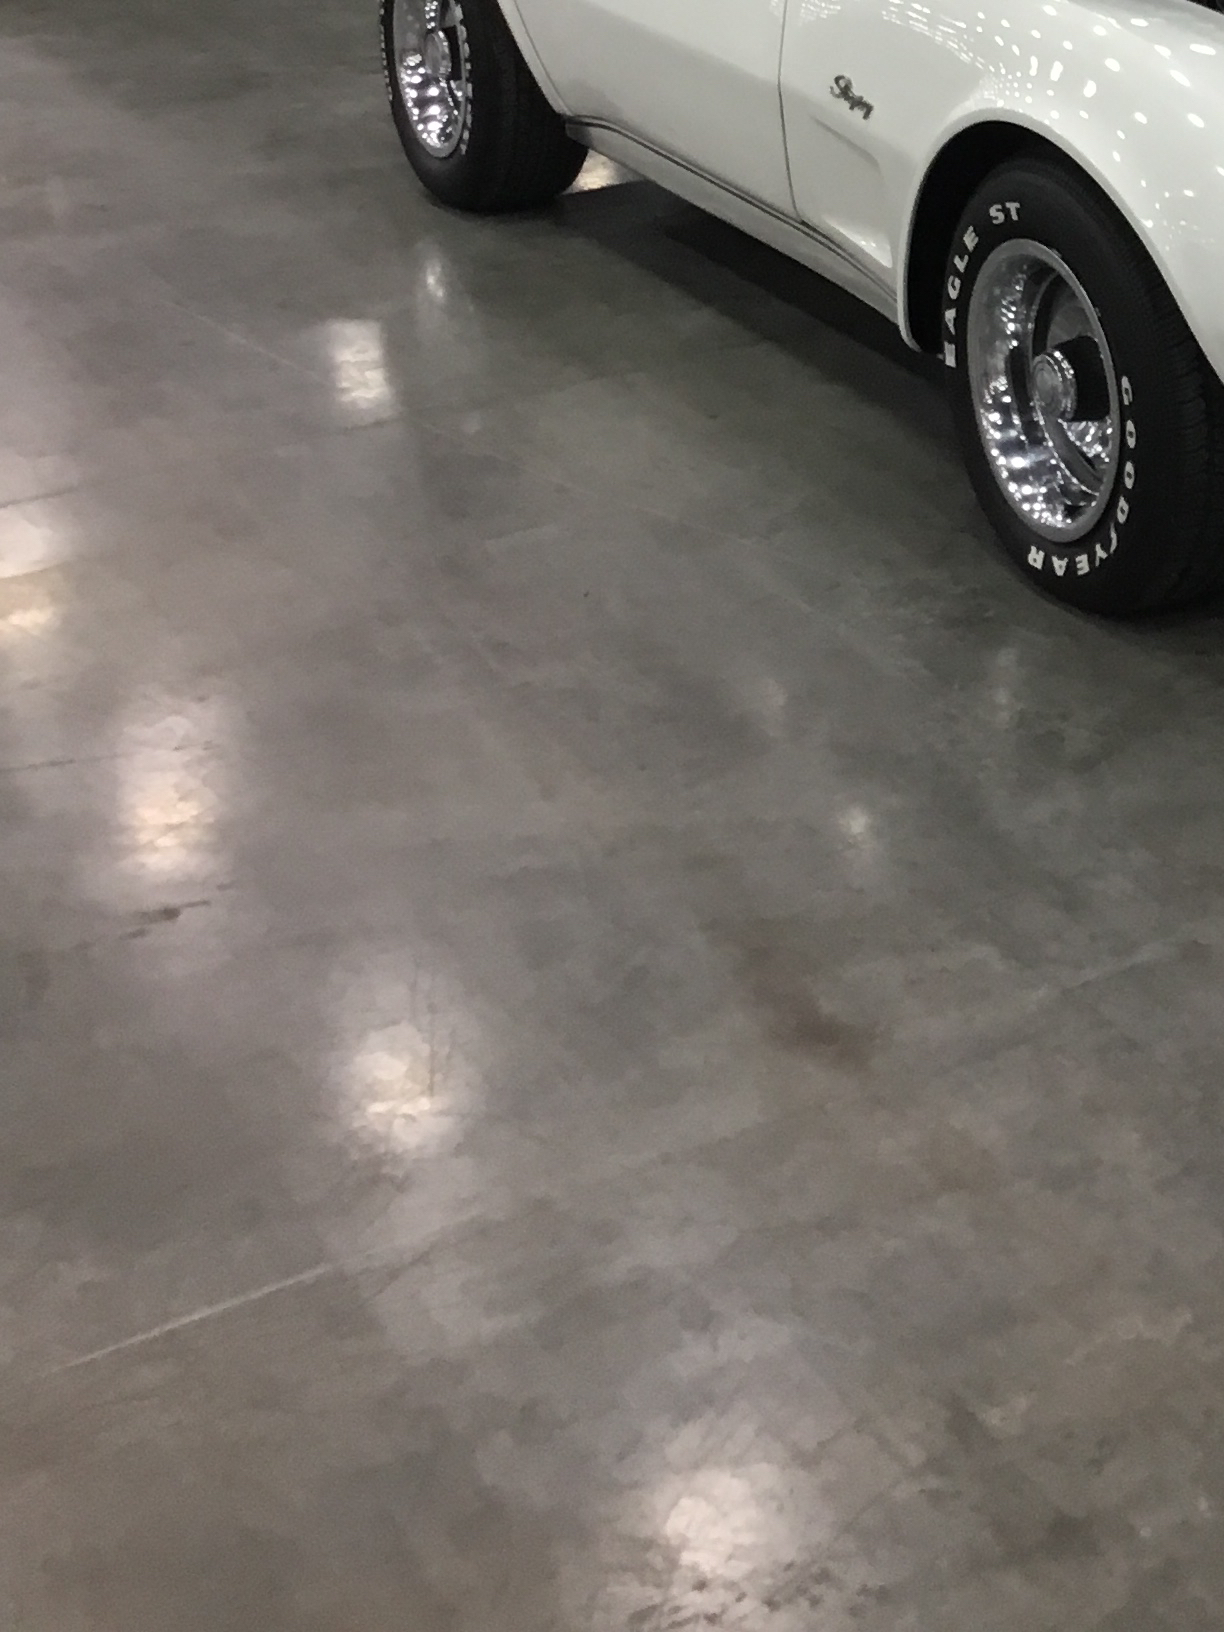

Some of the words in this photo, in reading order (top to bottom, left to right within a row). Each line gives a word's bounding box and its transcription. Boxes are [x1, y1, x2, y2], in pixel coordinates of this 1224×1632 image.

[944, 225, 979, 368] EAGLE
[989, 201, 1021, 225] ST
[1028, 375, 1137, 577] GOODYEAR
